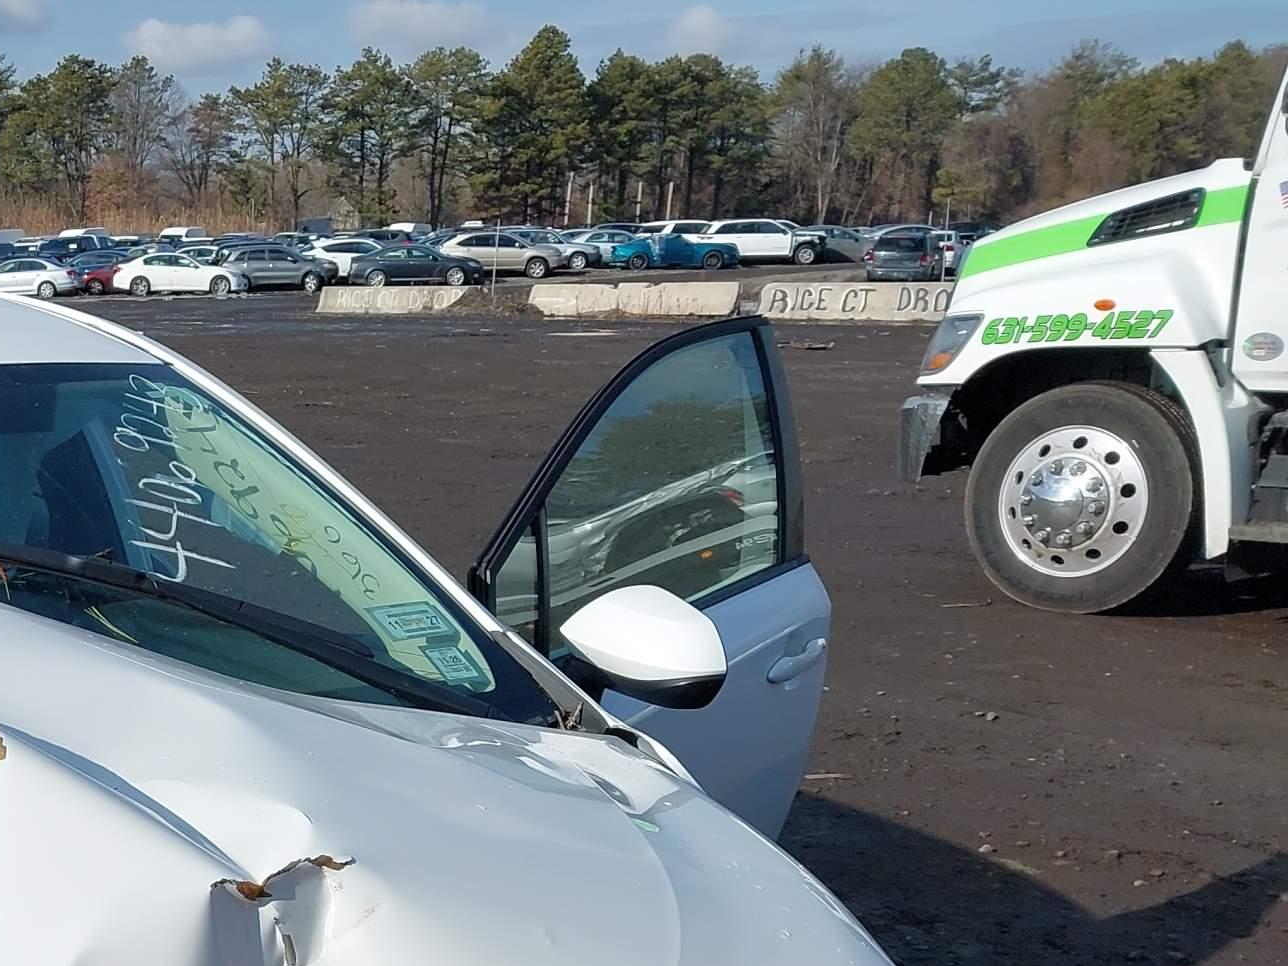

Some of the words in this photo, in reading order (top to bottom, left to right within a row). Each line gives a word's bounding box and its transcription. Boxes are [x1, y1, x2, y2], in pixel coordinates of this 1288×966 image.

[768, 287, 833, 314] RICE
[841, 288, 877, 313] CT
[981, 309, 1174, 345] 631-599-4527
[425, 615, 442, 626] 27
